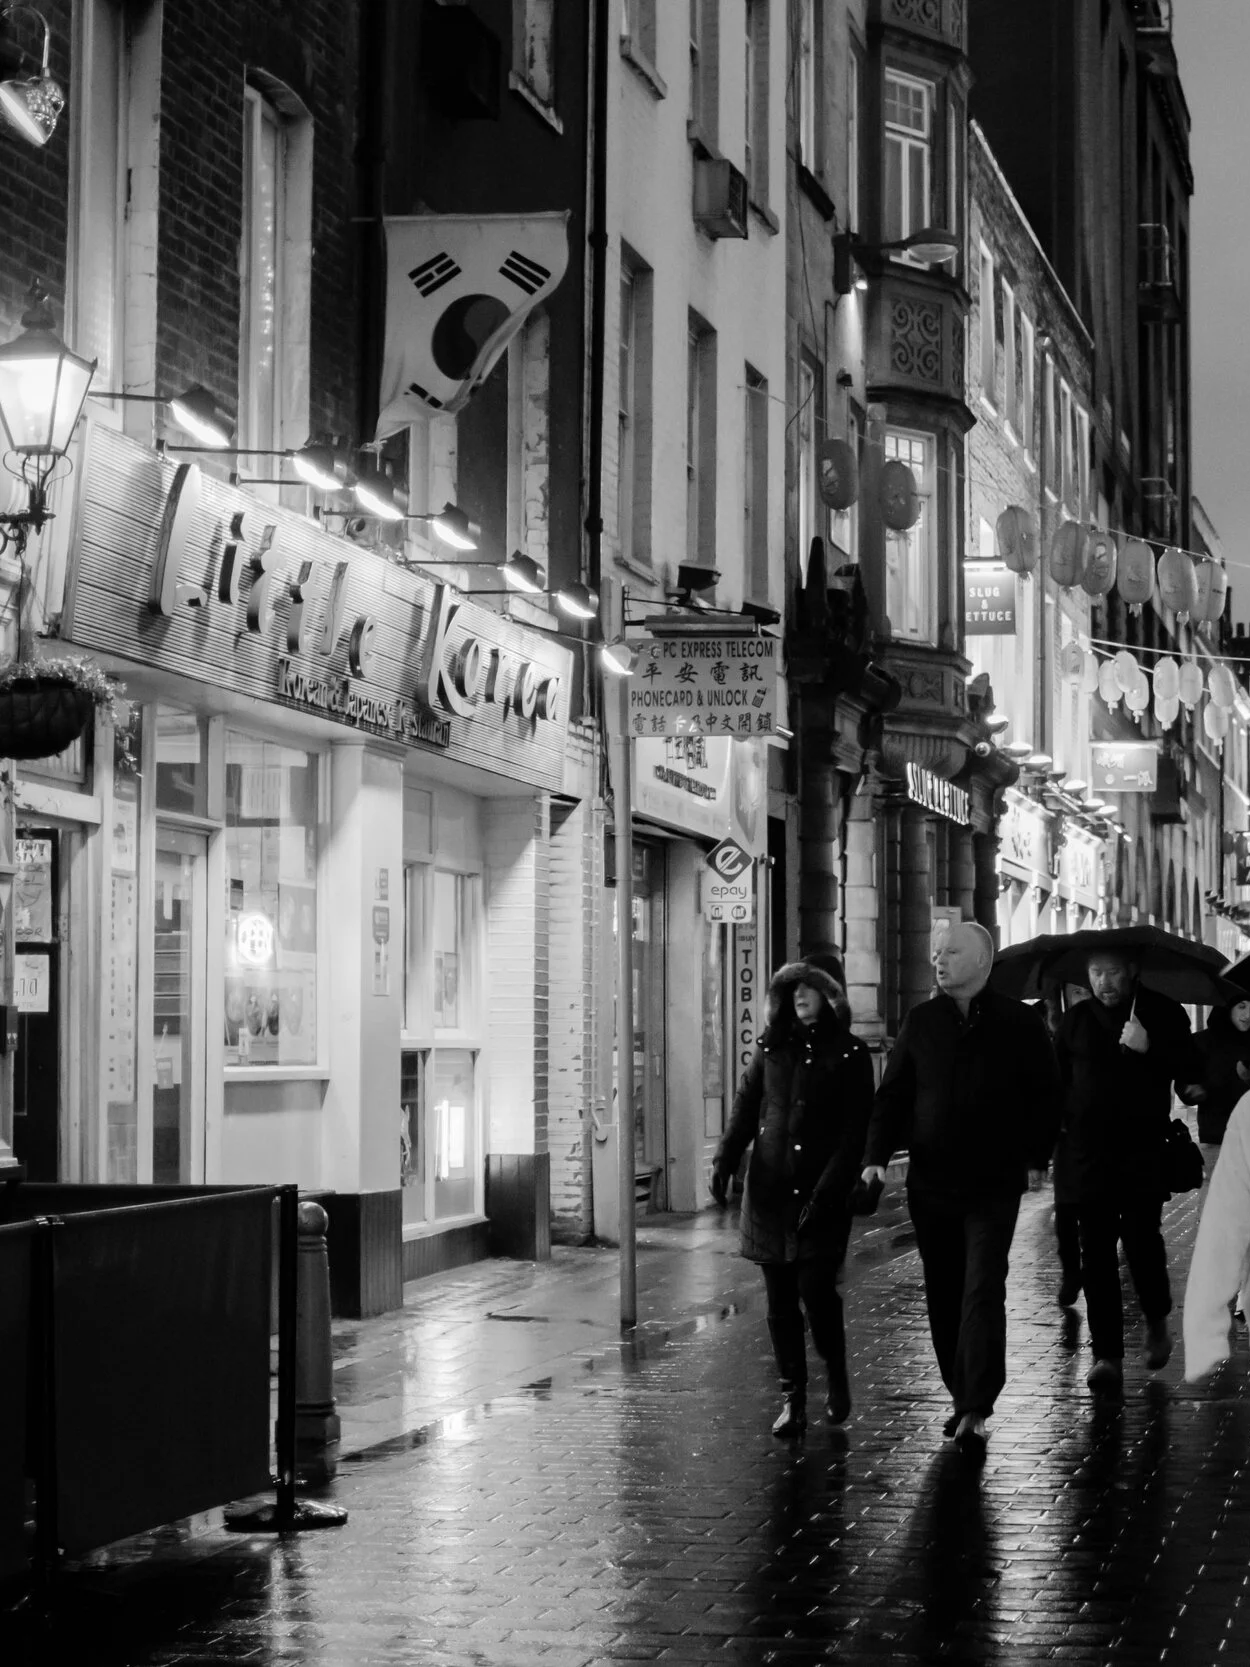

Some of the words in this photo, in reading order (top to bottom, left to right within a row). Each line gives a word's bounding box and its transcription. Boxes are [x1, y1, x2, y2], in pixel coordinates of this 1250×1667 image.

[147, 463, 378, 679] Little
[418, 583, 561, 717] Korea
[968, 586, 1000, 598] SLUG
[965, 611, 1012, 621] ETTUCE
[663, 641, 677, 659] PC
[681, 641, 722, 658] EXPRESS
[725, 640, 773, 658] TELECOM
[641, 661, 763, 685] 平安電訊
[631, 690, 693, 707] PHONECARD
[696, 691, 704, 706] &
[707, 689, 748, 706] UNLOCK
[711, 886, 747, 900] epay
[740, 949, 753, 1068] TOBACC
